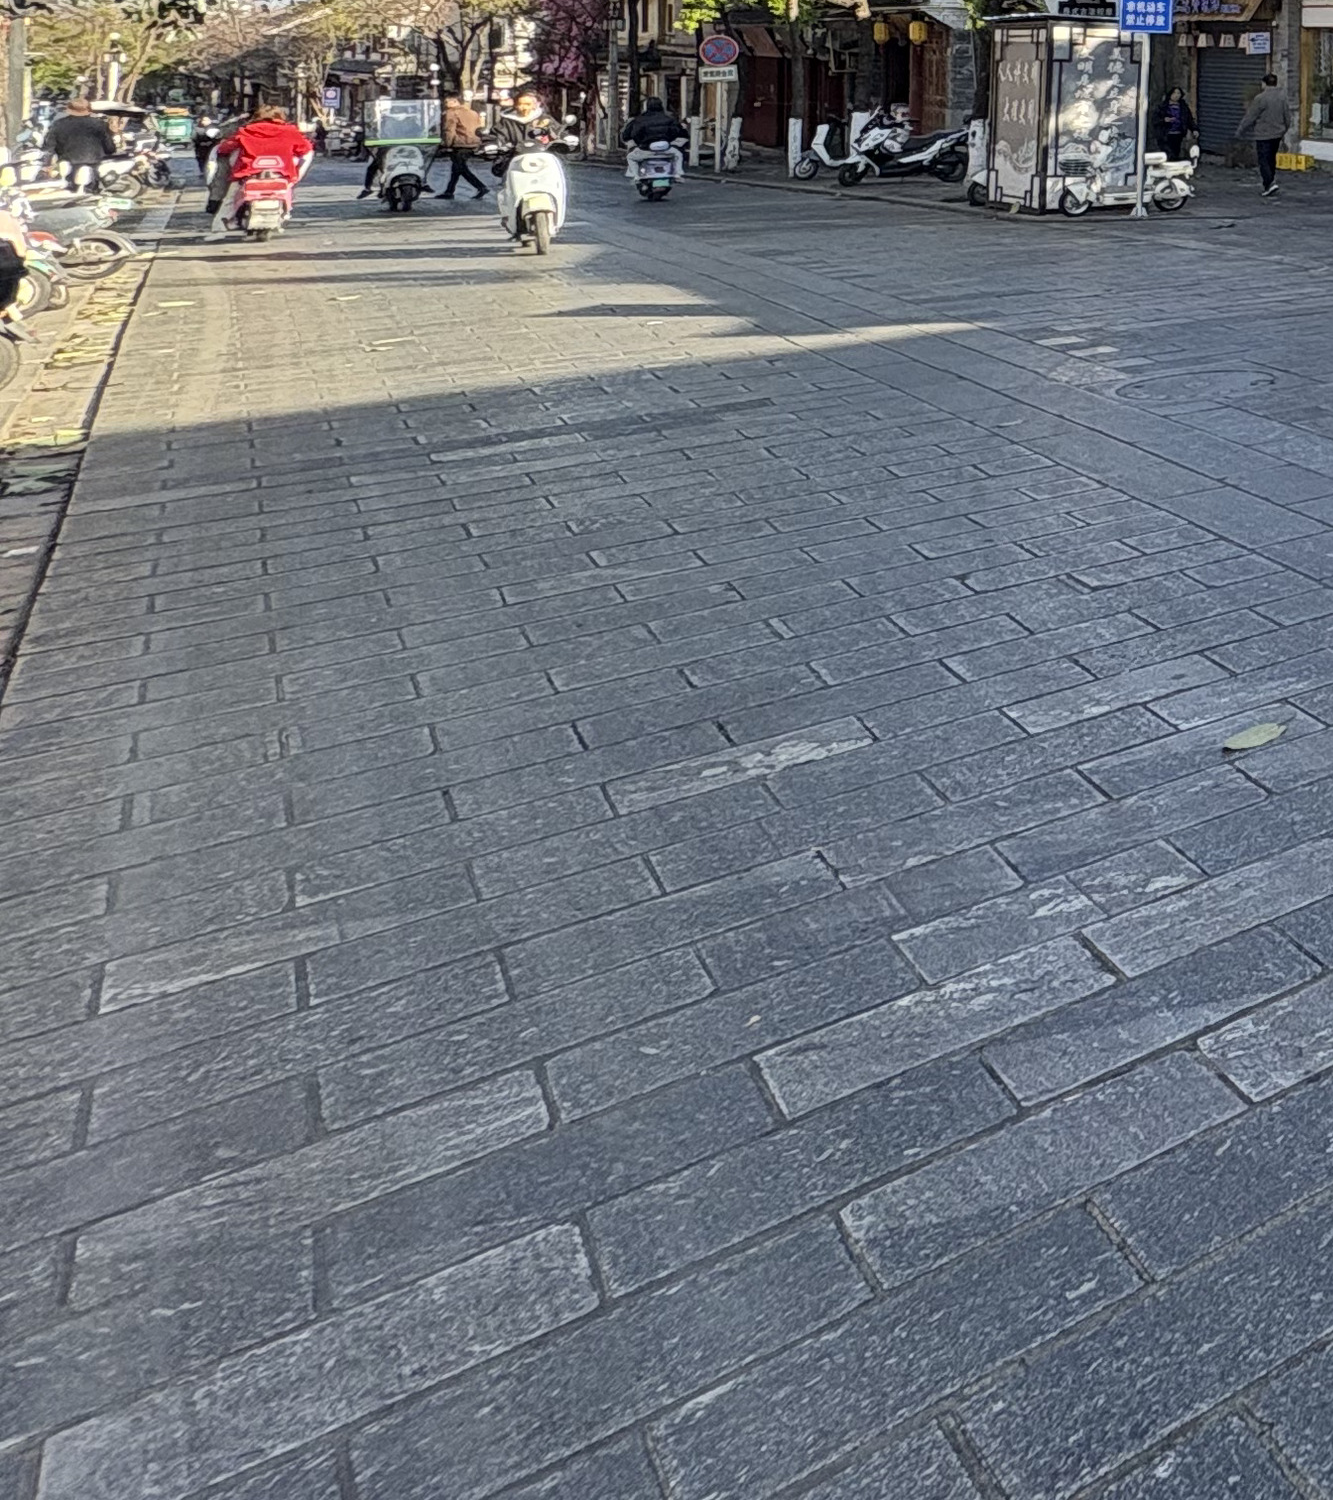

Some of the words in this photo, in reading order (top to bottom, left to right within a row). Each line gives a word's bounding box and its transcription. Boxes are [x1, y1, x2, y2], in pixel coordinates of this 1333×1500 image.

[1126, 1, 1166, 13] 非机动车
[1125, 14, 1165, 26] 禁止停放
